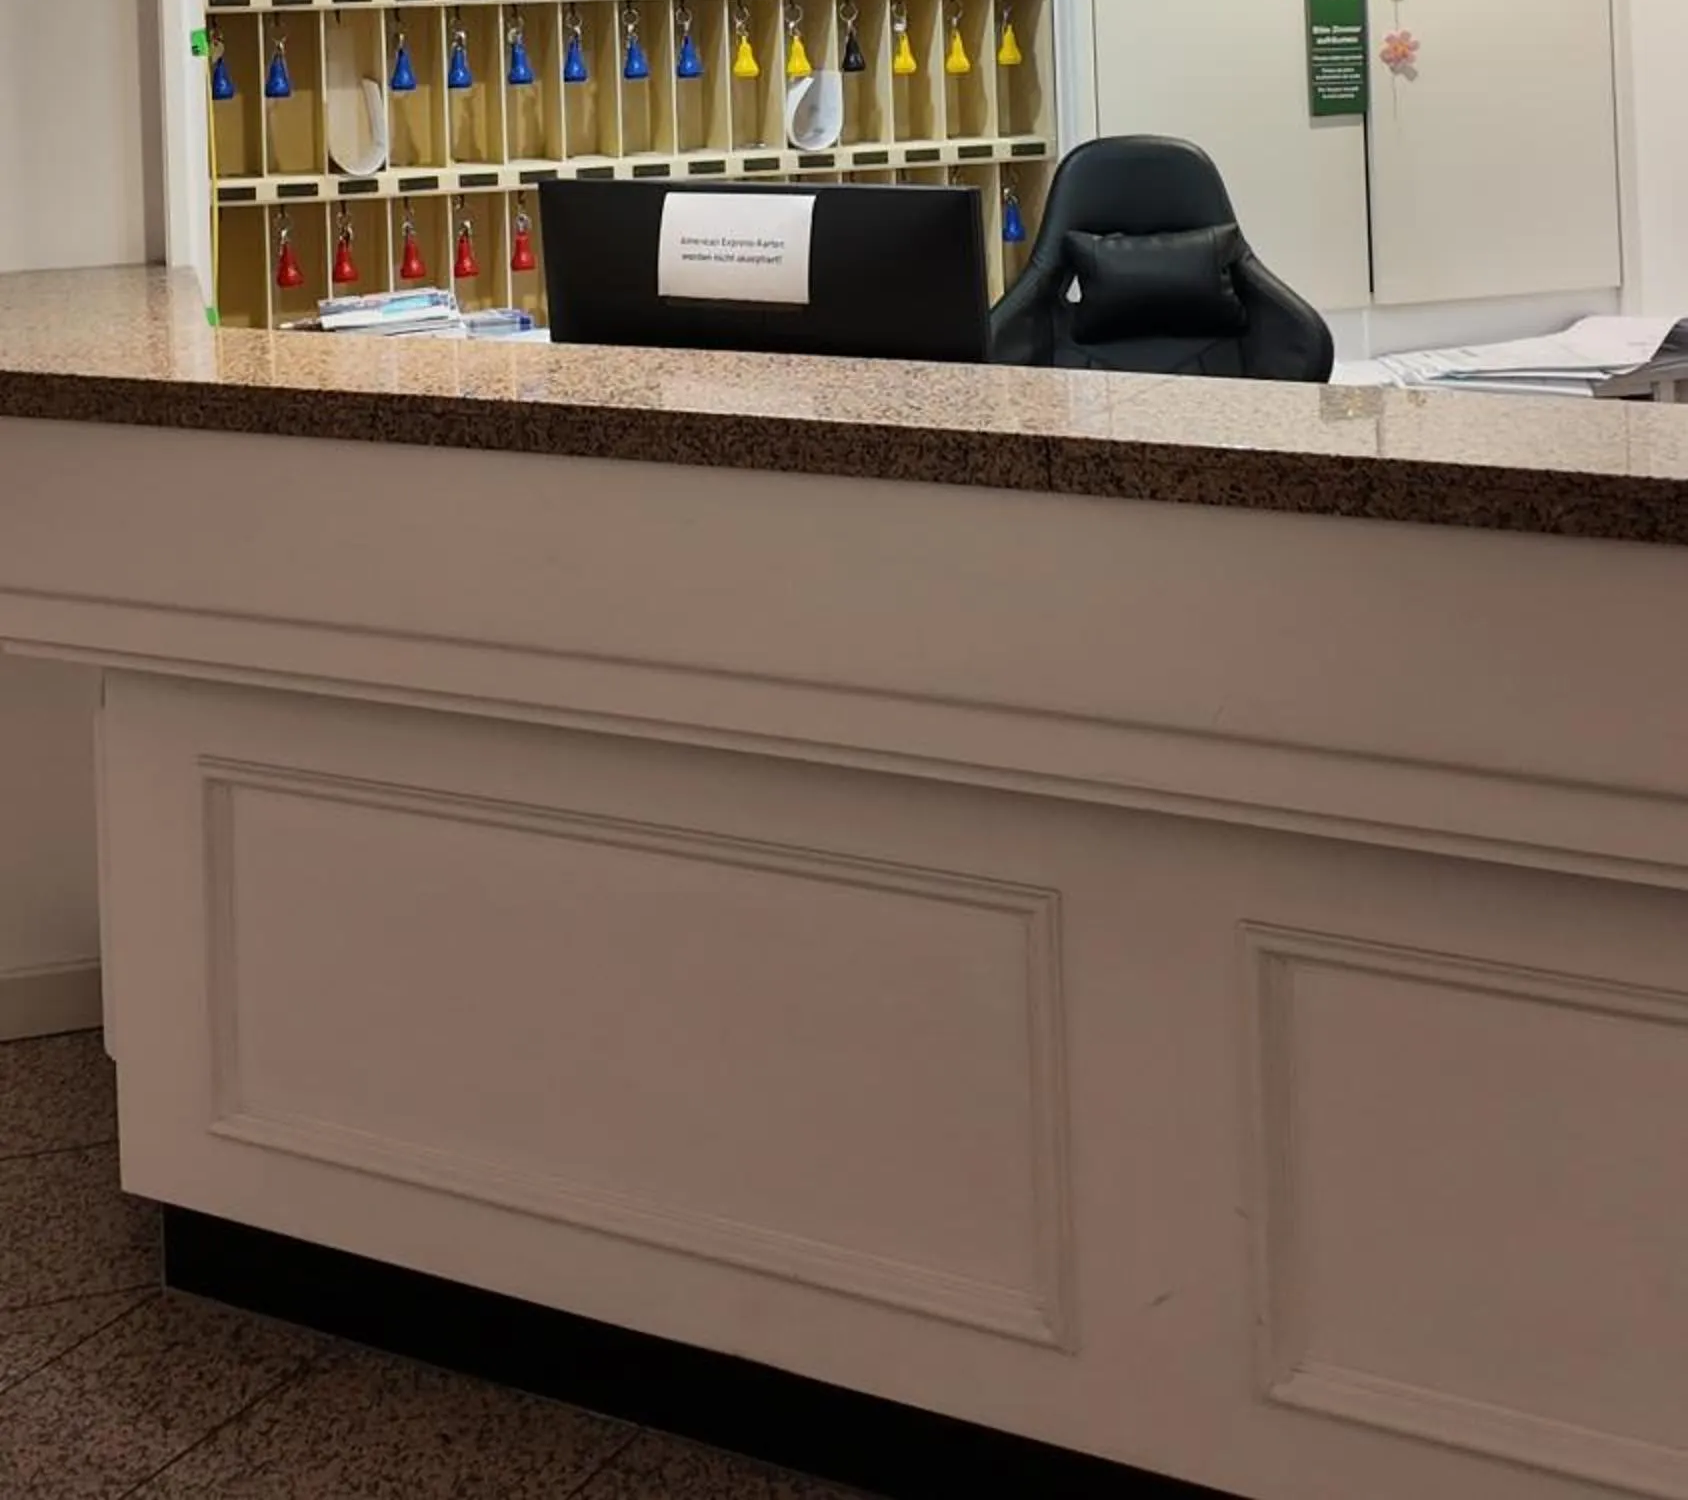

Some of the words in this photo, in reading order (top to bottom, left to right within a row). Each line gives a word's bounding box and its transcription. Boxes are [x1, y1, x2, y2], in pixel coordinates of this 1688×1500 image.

[681, 236, 720, 246] American
[681, 253, 712, 262] werden
[713, 254, 735, 263] nicht
